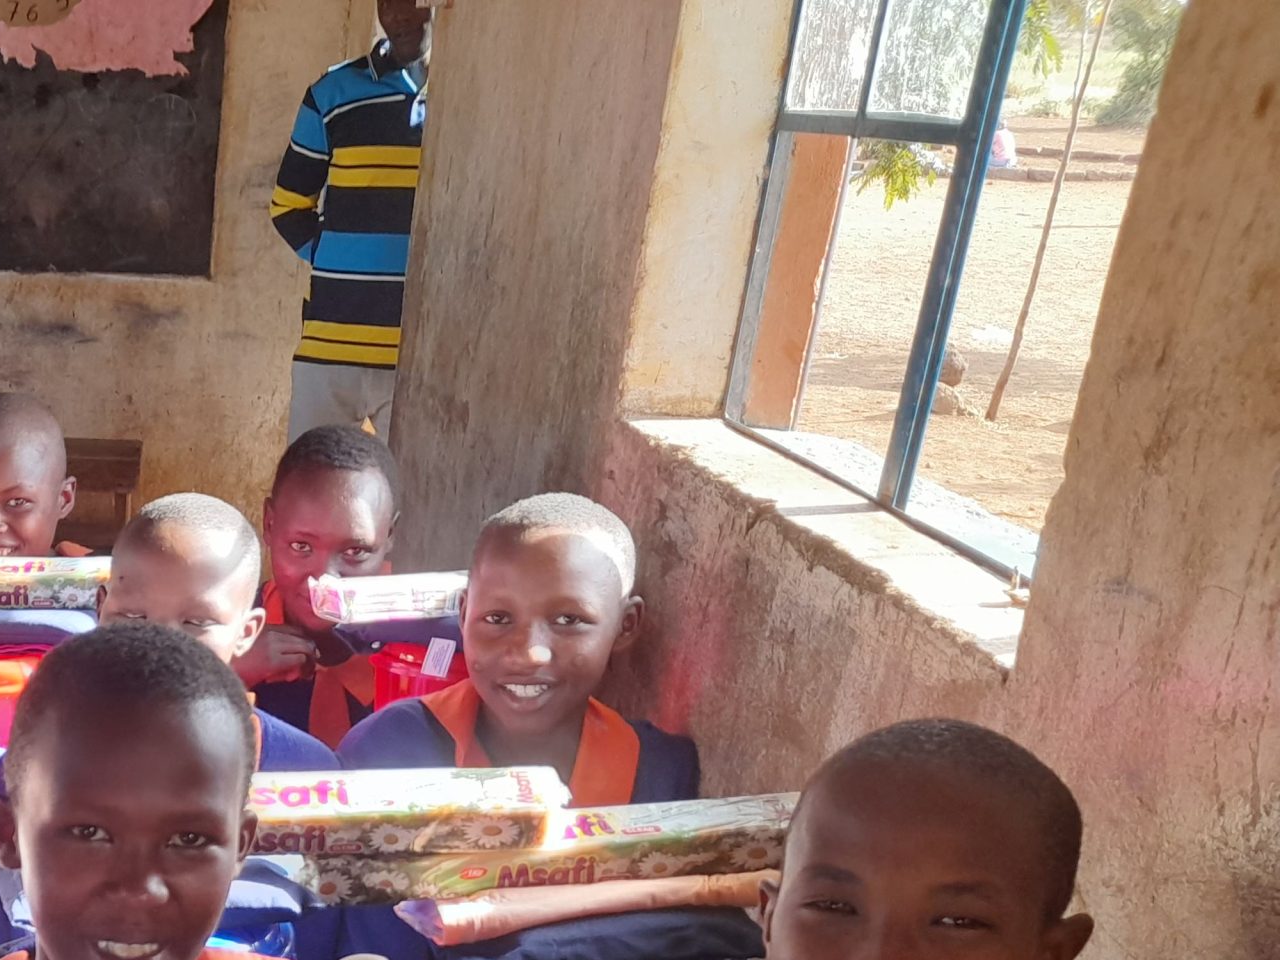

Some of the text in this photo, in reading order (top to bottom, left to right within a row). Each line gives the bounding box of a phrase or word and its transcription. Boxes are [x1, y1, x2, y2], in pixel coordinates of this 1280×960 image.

[26, 3, 38, 22] 6
[251, 779, 349, 808] safi
[253, 825, 326, 852] safi
[497, 856, 595, 887] Msafi
